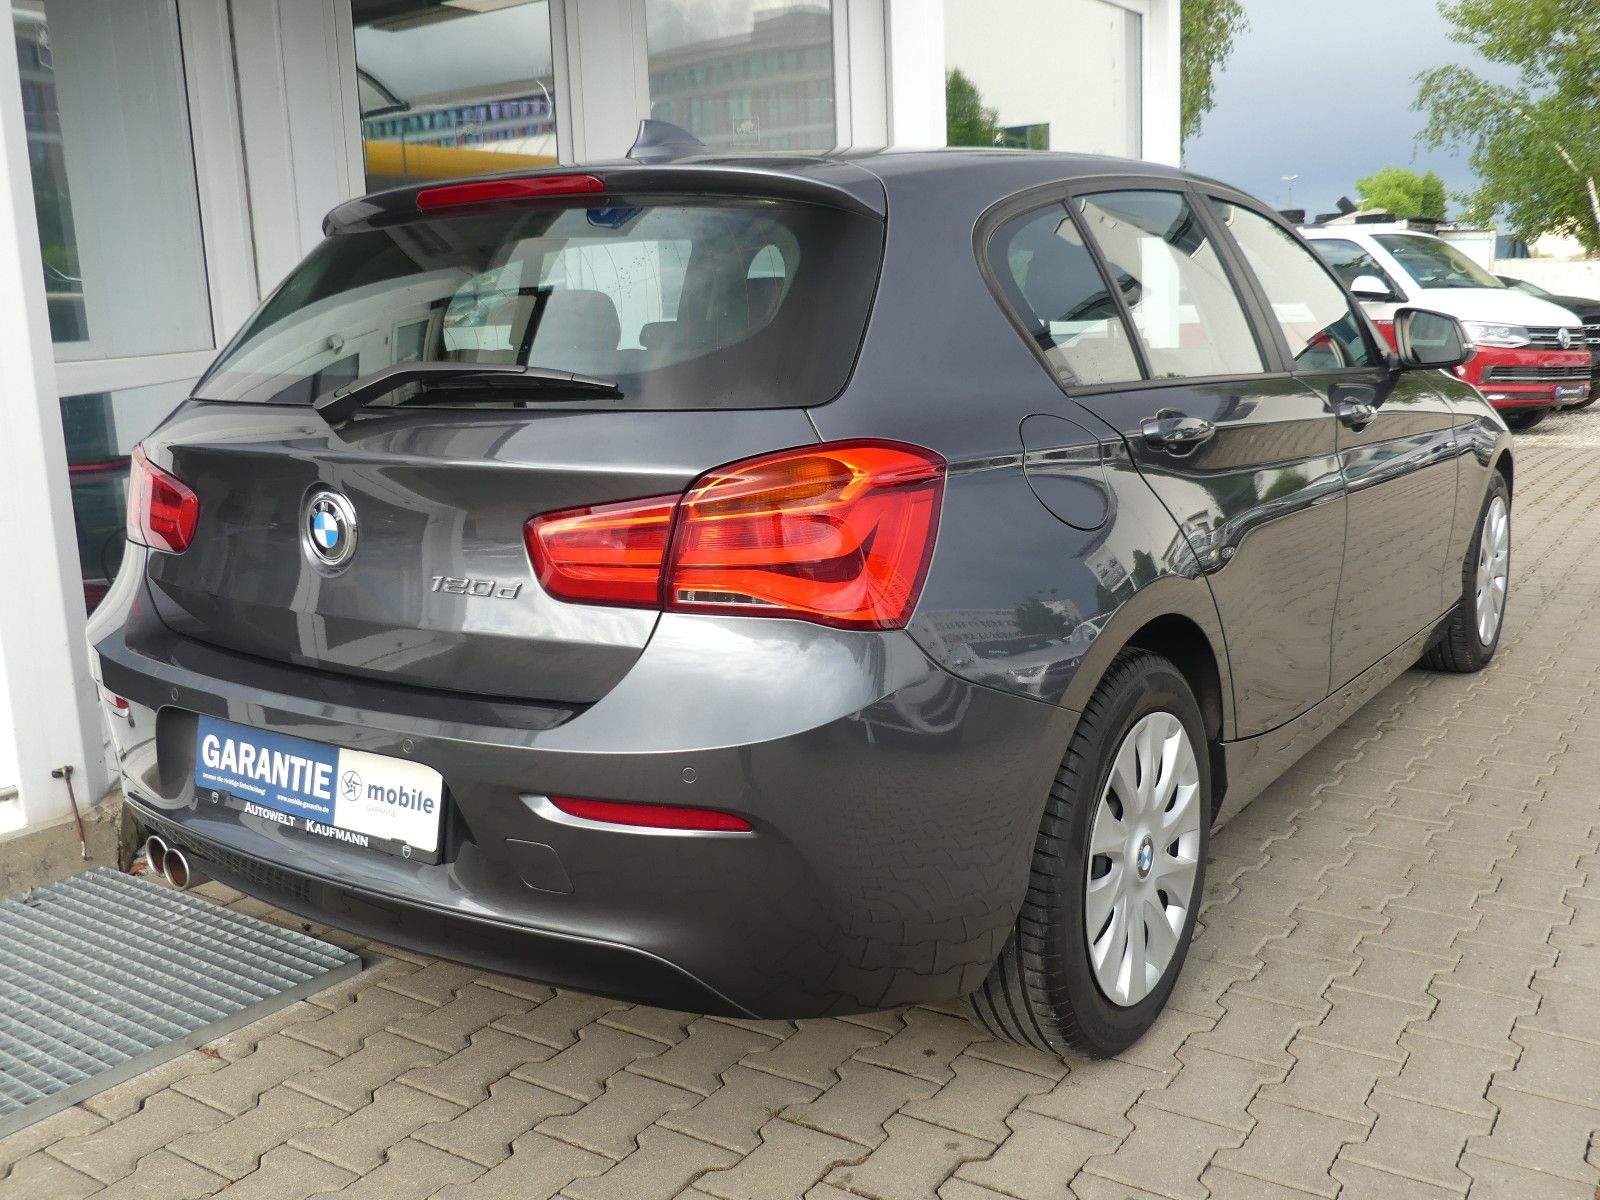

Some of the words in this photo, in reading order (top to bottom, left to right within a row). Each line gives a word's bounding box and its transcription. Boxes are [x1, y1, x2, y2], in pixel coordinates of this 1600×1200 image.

[432, 575, 522, 600] 120d
[202, 733, 332, 800] GARANTIE
[367, 783, 435, 814] mobile
[244, 801, 295, 827] AUTOWELT
[306, 819, 368, 847] KAUFMANN
